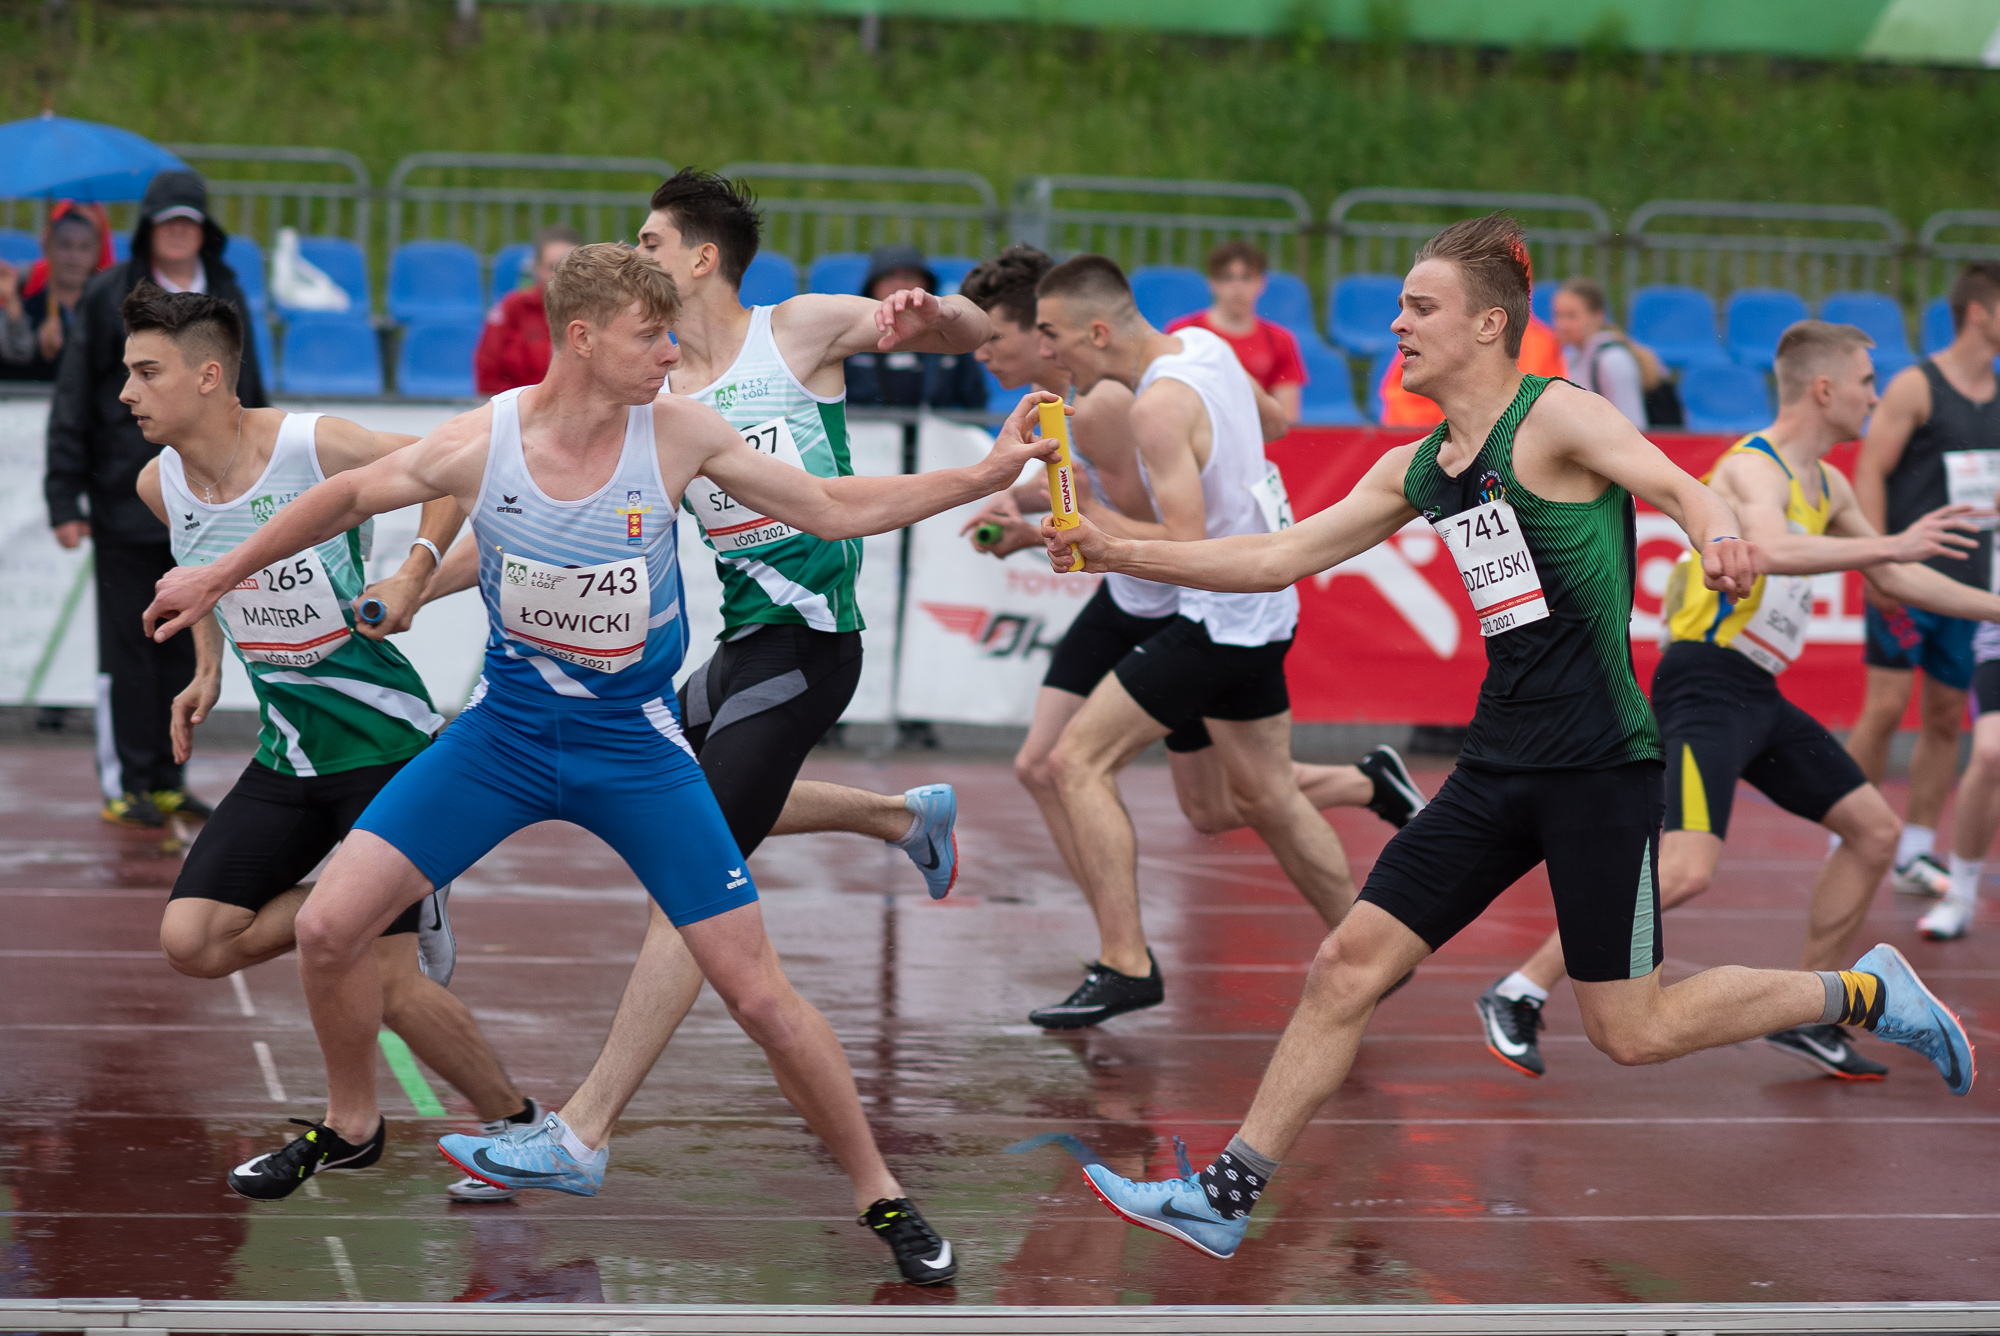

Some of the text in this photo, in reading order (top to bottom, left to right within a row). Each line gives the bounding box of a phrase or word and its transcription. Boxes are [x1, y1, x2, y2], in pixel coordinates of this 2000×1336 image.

[741, 378, 762, 390] AZS
[743, 384, 770, 400] ŁÓDŹ
[1060, 469, 1071, 513] POLANIK
[497, 506, 522, 514] erima
[184, 521, 201, 531] erima
[733, 529, 762, 547] ŁÓDŹ
[763, 525, 791, 541] 2021
[1457, 508, 1509, 548] 741
[263, 558, 313, 592] 265
[531, 572, 552, 581] AZS
[1460, 550, 1530, 592] DZIEJSKI
[531, 580, 556, 590] ŁÓDŹ
[577, 567, 637, 598] 743
[242, 604, 321, 628] MATERA
[520, 607, 630, 634] ŁOWICKI
[1493, 613, 1515, 631] 2021
[293, 651, 321, 665] 2021
[540, 646, 612, 671] ŁÓDŹ 2021
[726, 877, 748, 890] erima
